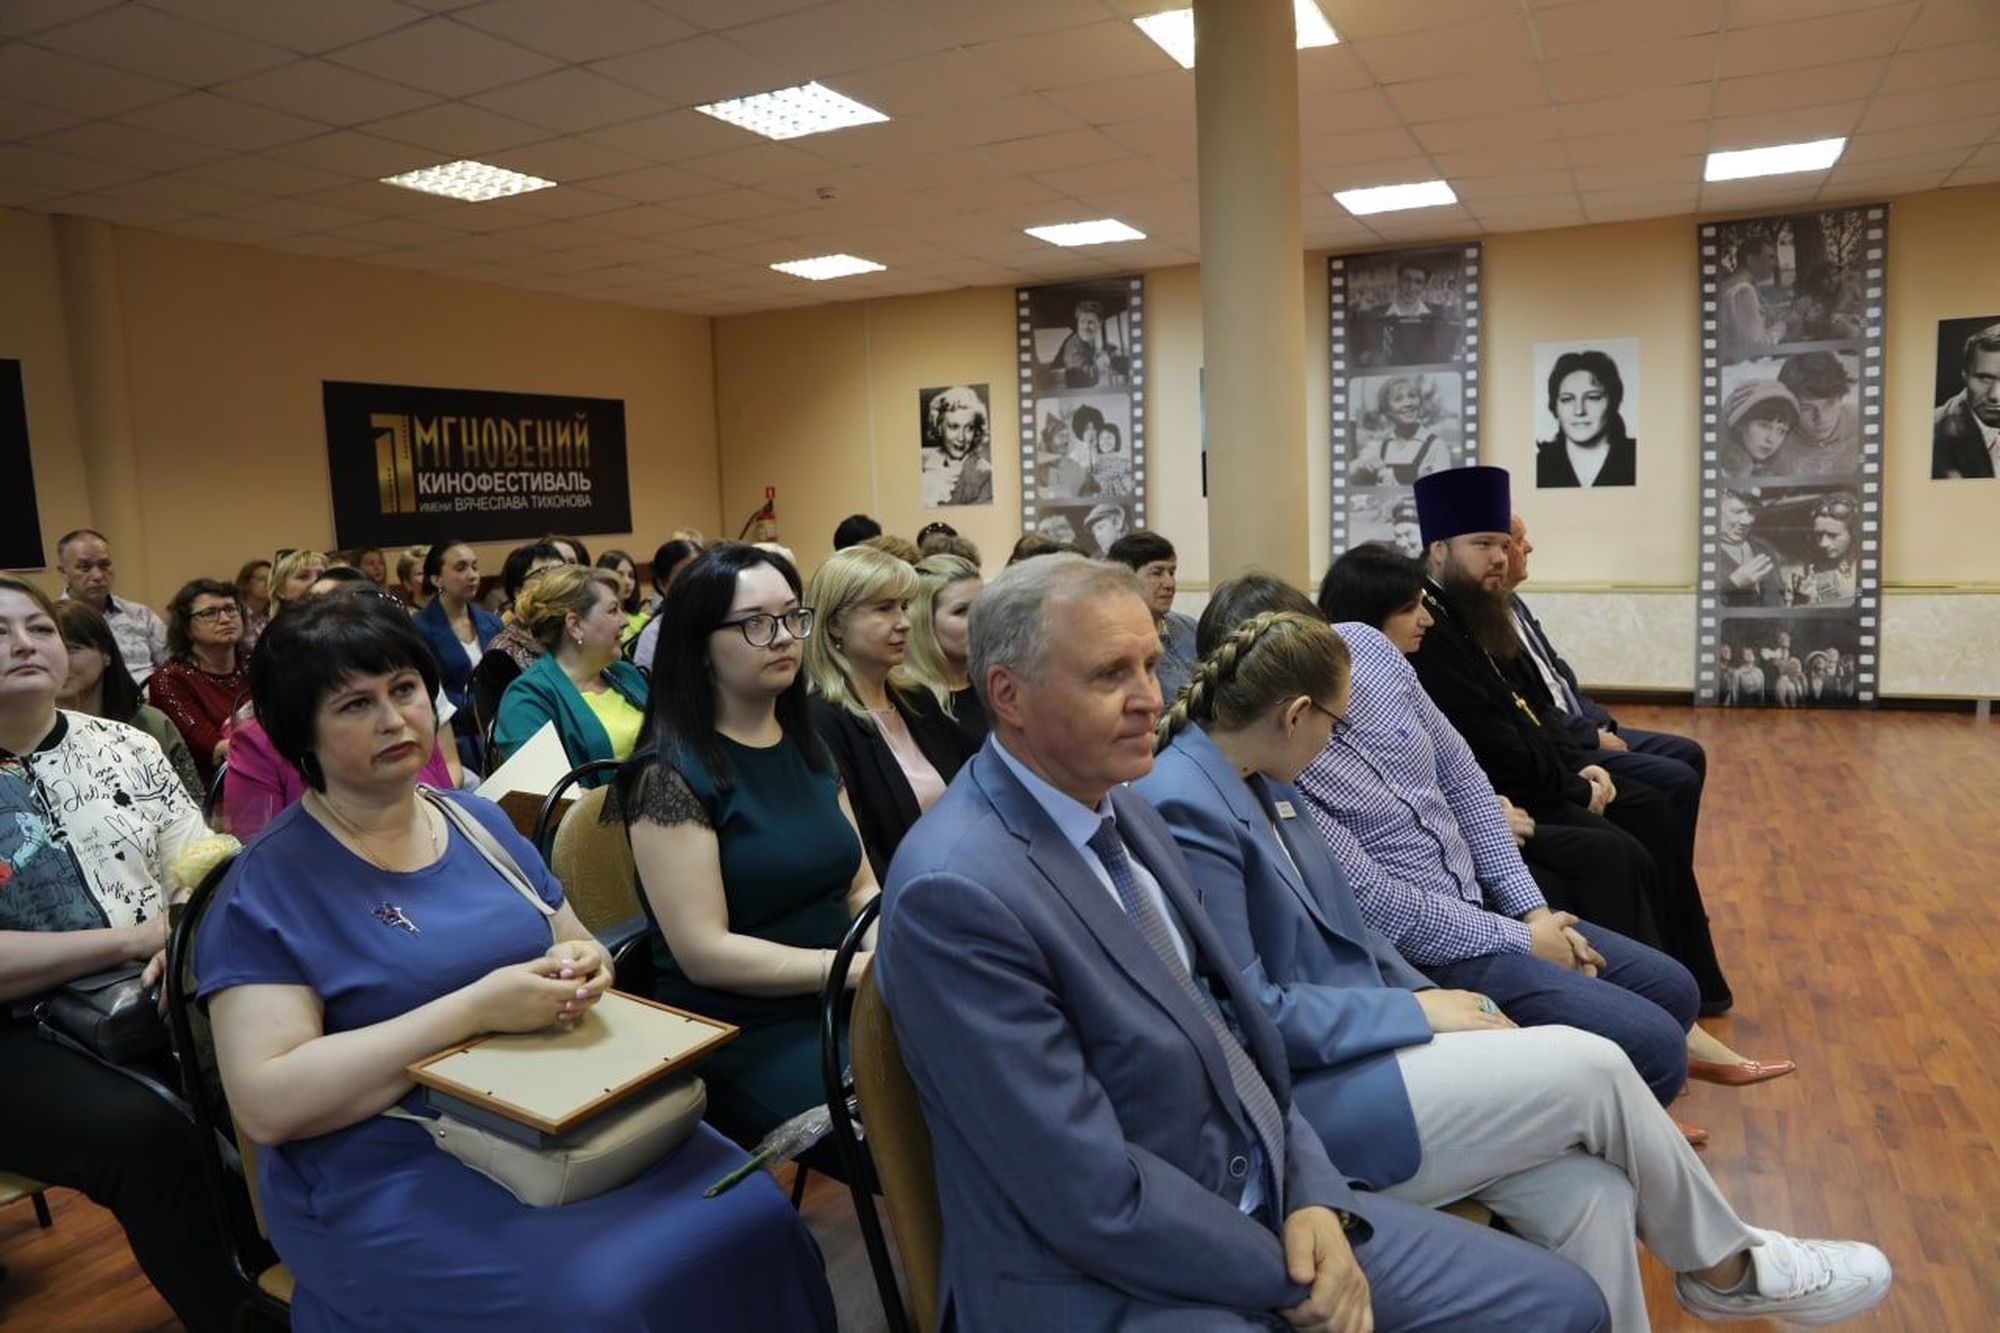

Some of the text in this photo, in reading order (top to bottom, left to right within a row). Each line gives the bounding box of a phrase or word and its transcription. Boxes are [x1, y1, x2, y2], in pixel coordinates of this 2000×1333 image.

[414, 412, 591, 468] МГНОВЕНИЙ
[418, 471, 592, 494] КИНОФЕСТИВАЛЬ
[454, 497, 528, 512] ВЯЧЕСЛАВА
[531, 494, 592, 508] ТИХОНОВА
